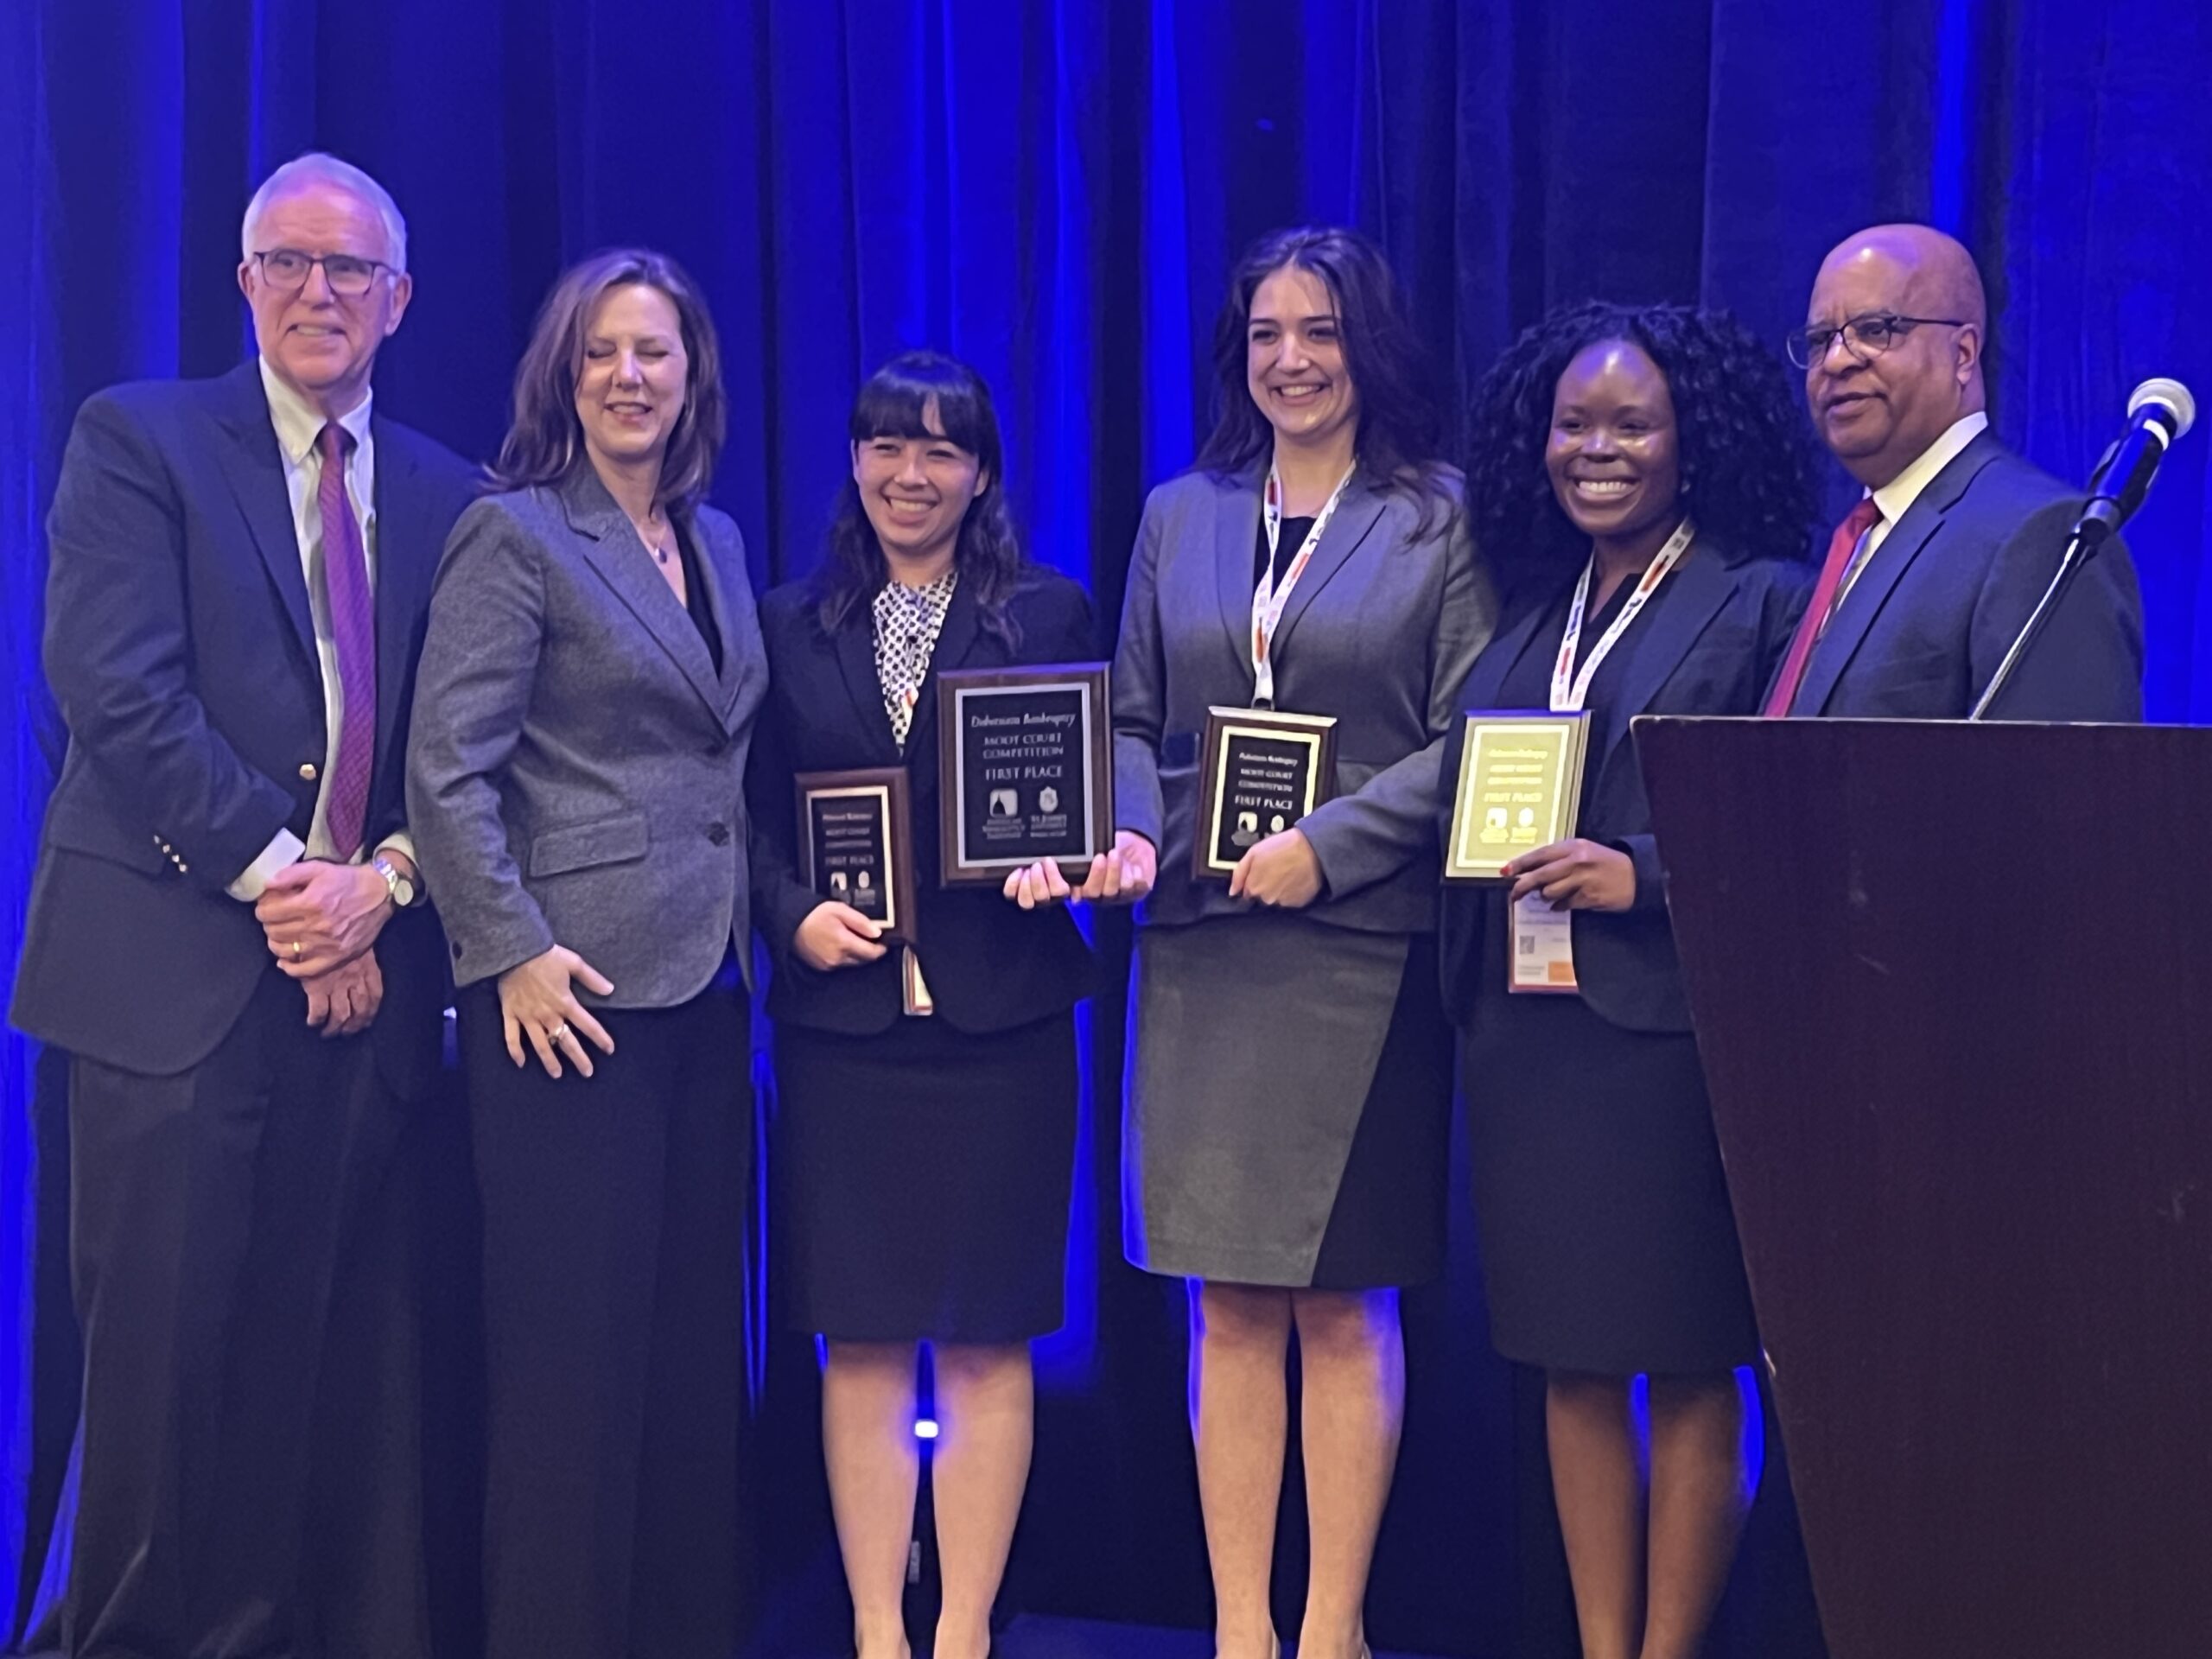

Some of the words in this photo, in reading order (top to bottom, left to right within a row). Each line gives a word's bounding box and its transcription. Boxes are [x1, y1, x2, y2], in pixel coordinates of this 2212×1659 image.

[984, 735, 1019, 745] MOOT
[1023, 733, 1061, 744] COURT
[983, 747, 1063, 759] COMPETITION
[986, 767, 1020, 780] FIRST
[1025, 766, 1062, 779] PLACE
[1235, 794, 1262, 807] FIRST
[1263, 798, 1293, 810] PLACE
